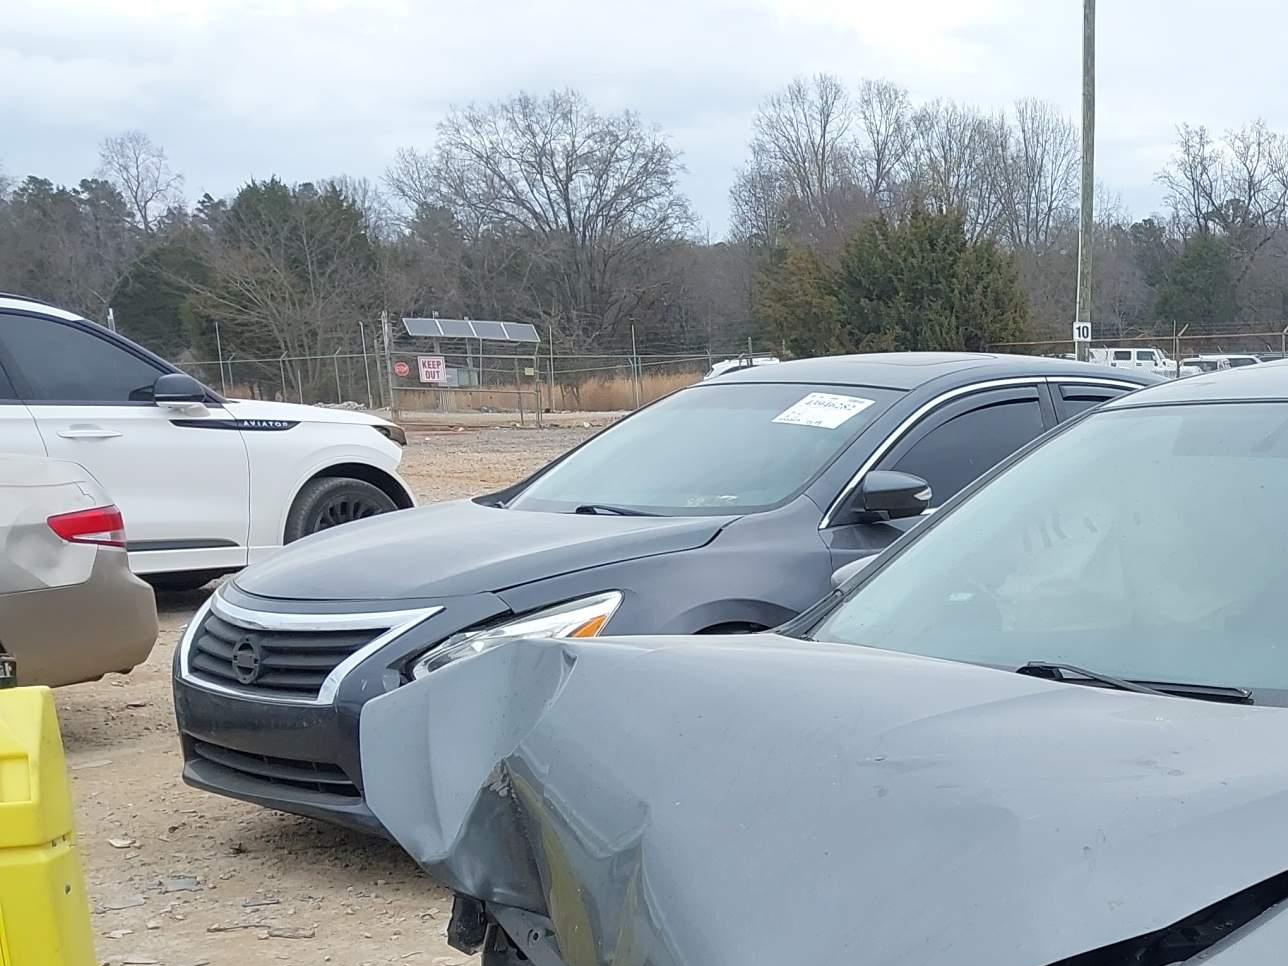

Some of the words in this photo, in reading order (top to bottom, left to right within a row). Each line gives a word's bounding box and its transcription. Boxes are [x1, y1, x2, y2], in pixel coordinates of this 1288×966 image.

[1075, 325, 1089, 339] 10
[421, 359, 442, 370] KEEP
[425, 371, 440, 379] OUT
